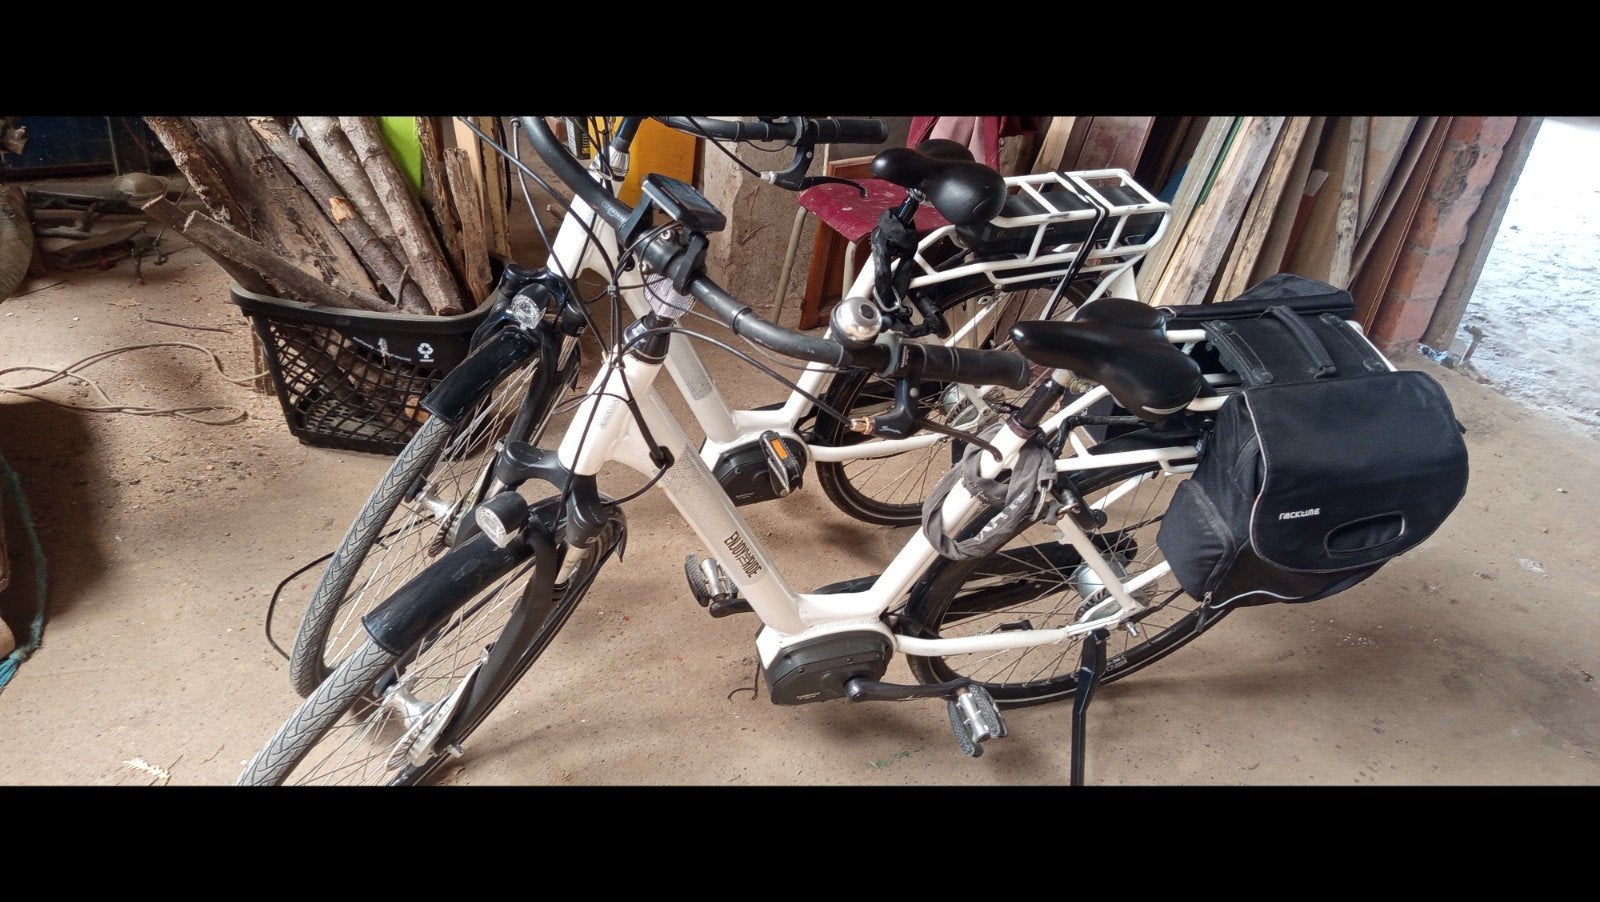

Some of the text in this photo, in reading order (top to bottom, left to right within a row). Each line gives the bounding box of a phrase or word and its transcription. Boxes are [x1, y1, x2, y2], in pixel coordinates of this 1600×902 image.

[1278, 508, 1320, 520] racktime
[724, 530, 748, 558] ENJOY
[742, 555, 762, 578] RIDE
